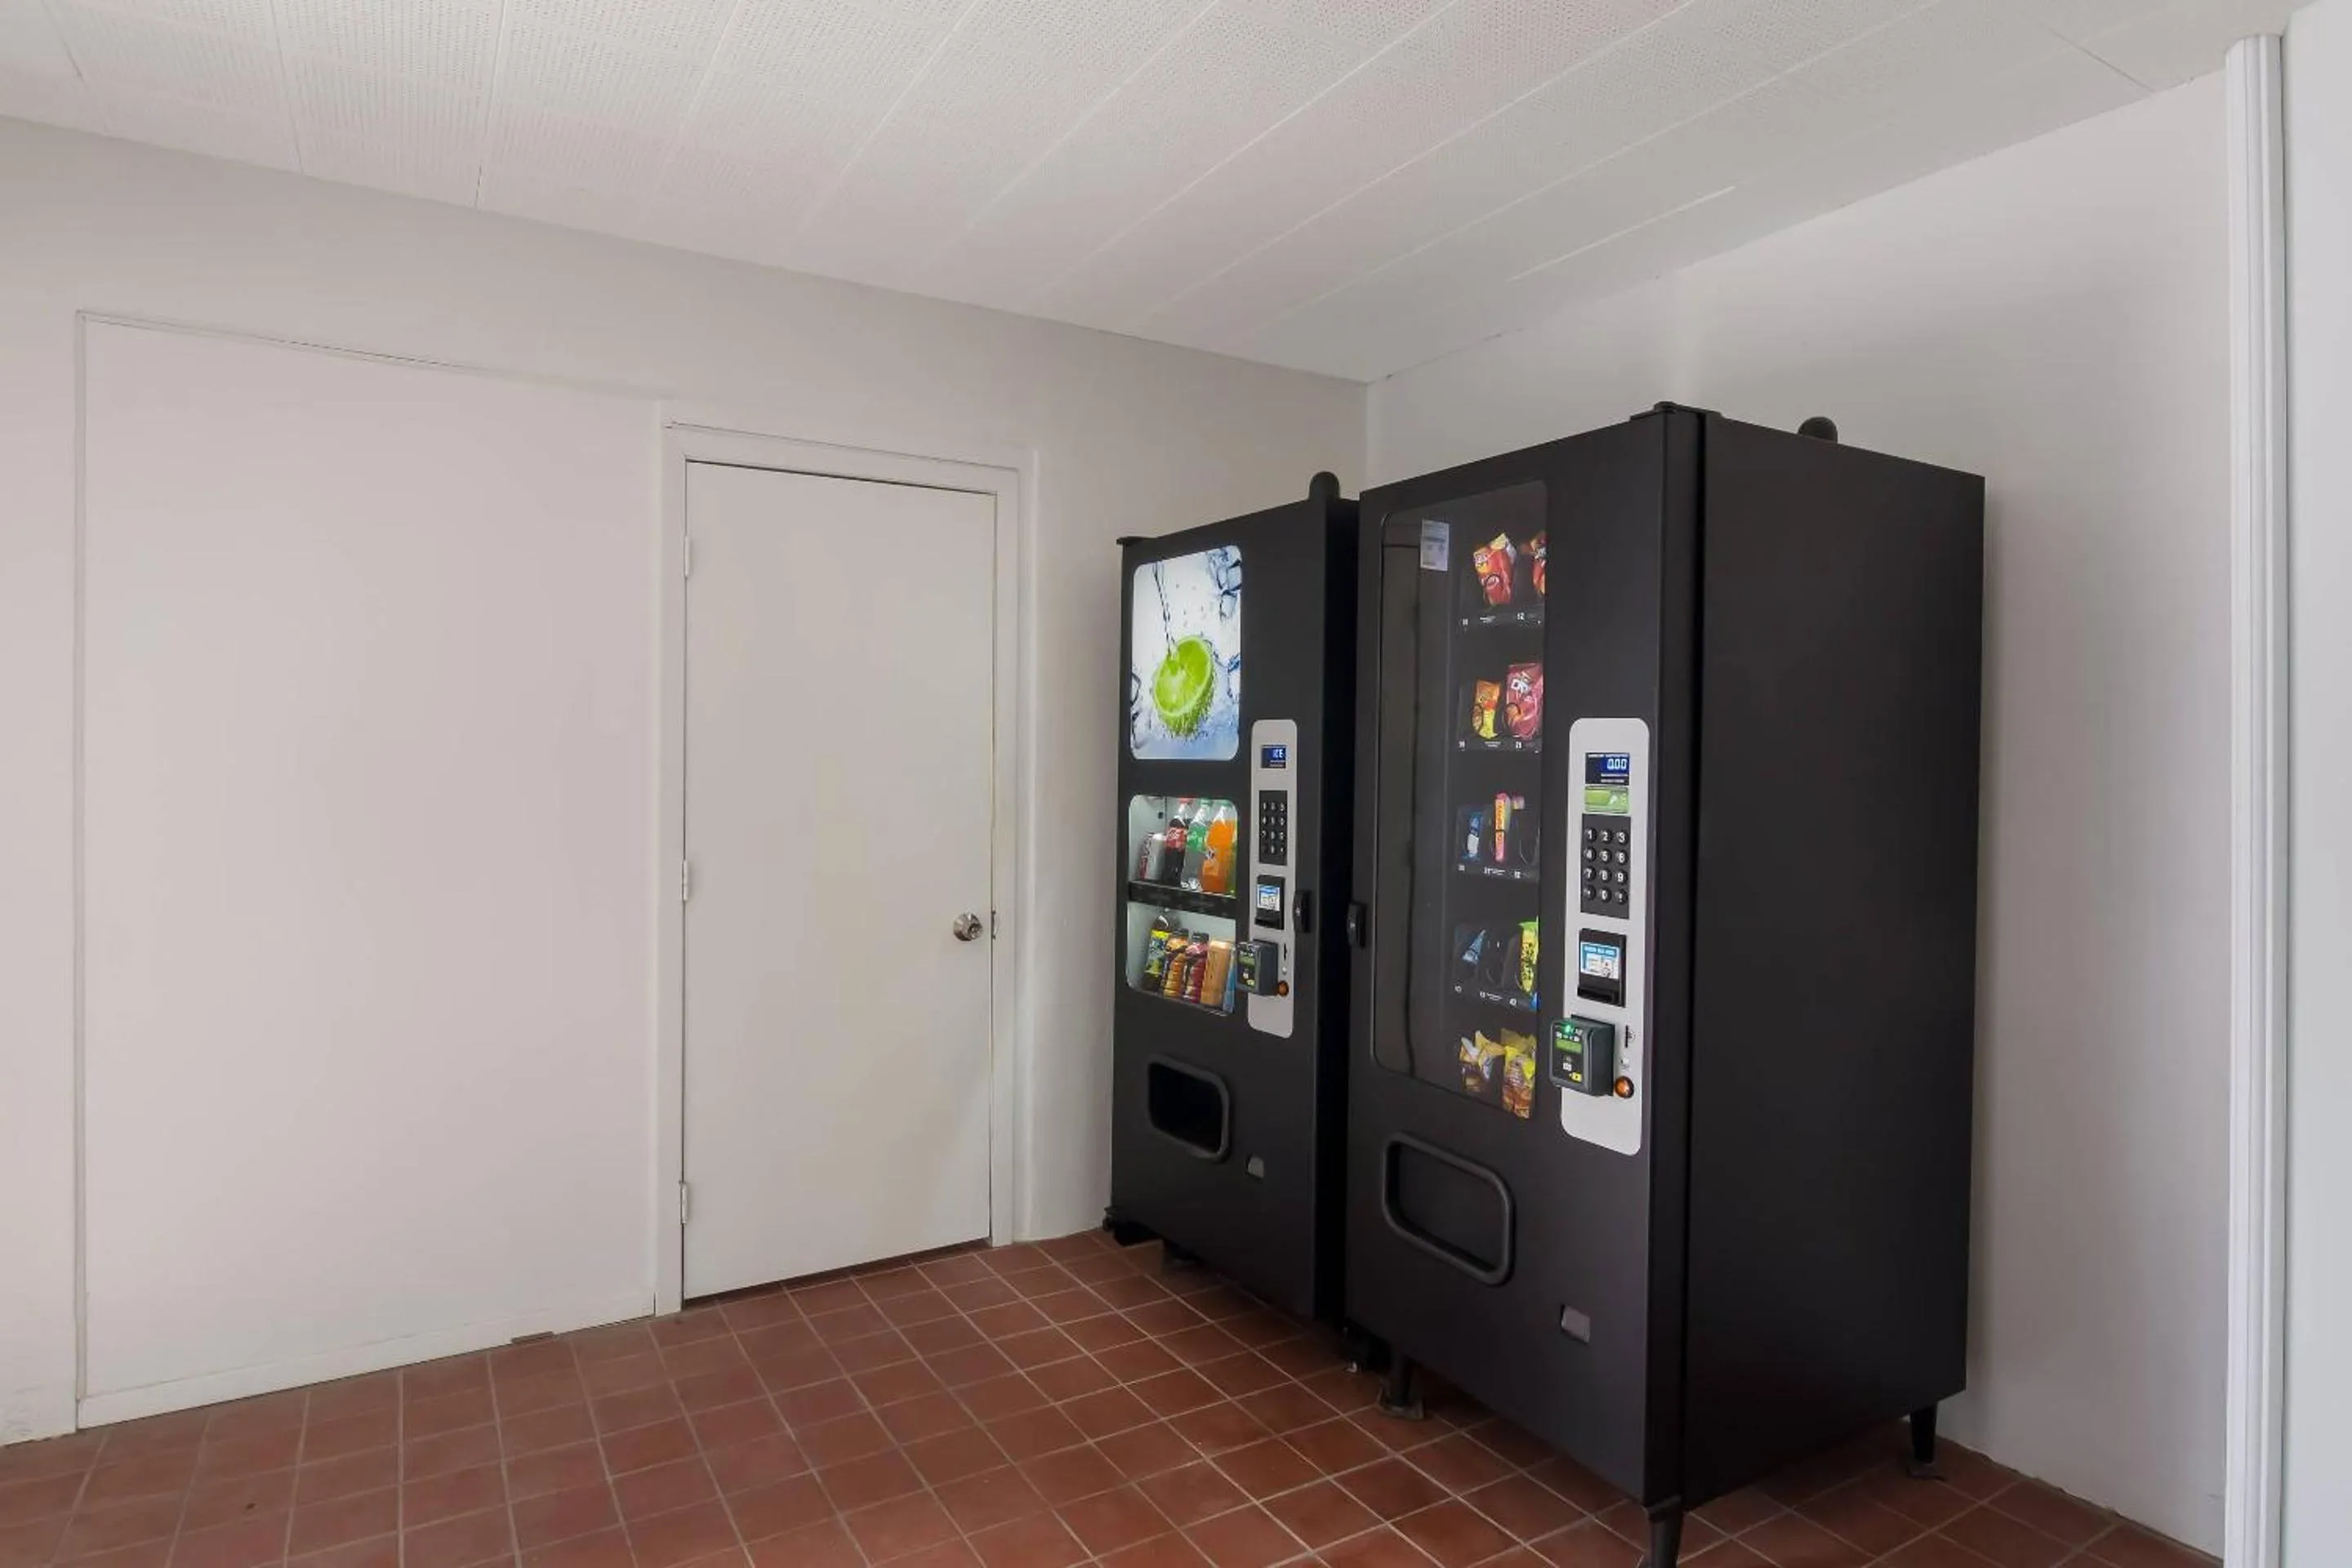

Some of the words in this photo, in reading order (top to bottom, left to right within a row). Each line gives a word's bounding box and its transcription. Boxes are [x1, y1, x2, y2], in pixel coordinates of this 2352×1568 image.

[1587, 829, 1592, 840] 1
[1601, 831, 1608, 841] 2
[1618, 831, 1625, 843] 3
[1601, 850, 1608, 862] 5
[1586, 868, 1592, 879] 7
[1617, 872, 1624, 883] 9
